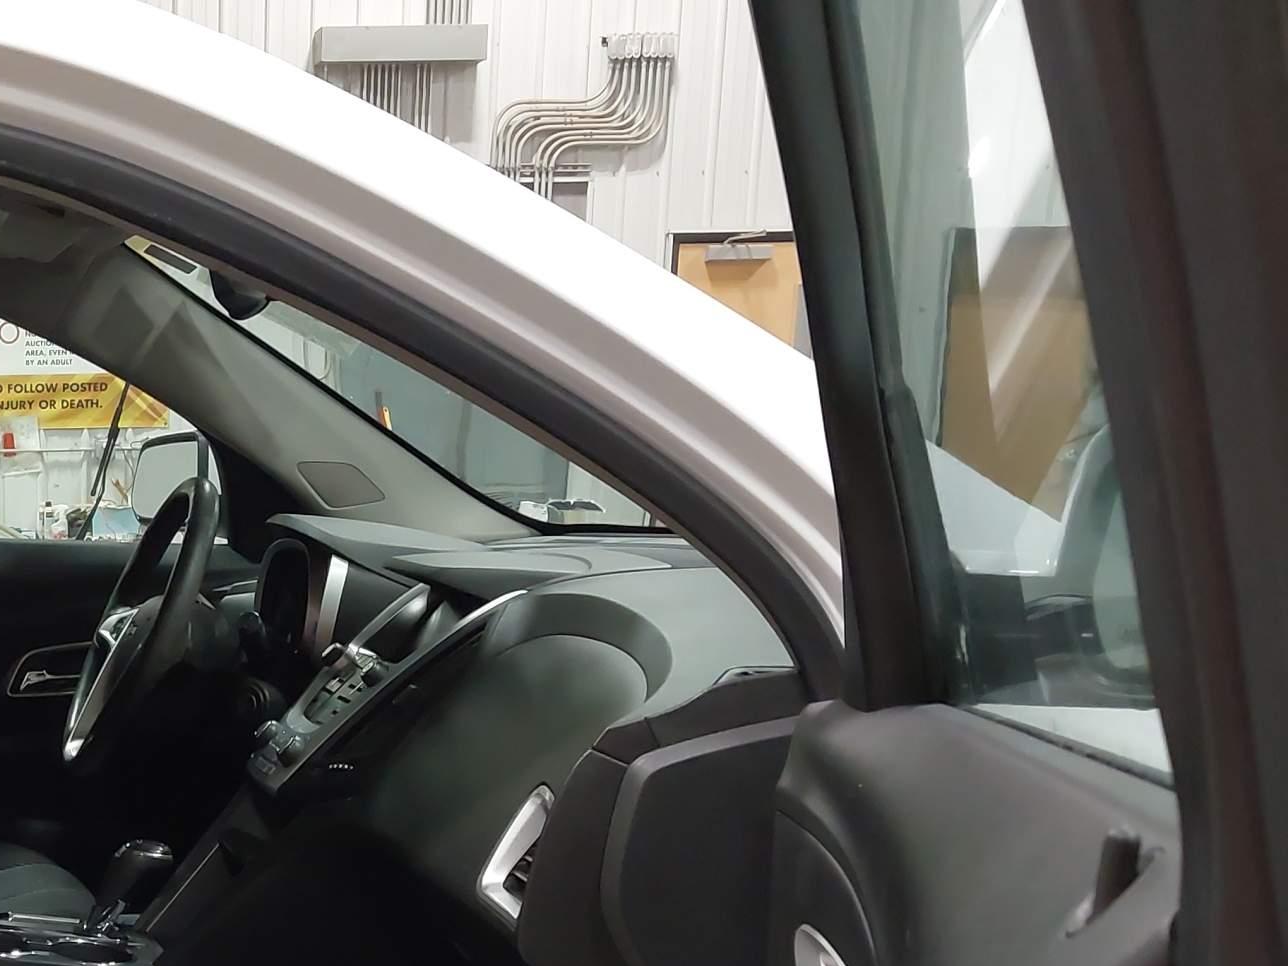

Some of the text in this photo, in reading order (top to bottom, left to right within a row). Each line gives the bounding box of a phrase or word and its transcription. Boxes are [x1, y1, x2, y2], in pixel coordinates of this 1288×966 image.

[8, 383, 58, 393] FOLLOW
[63, 382, 107, 392] POSTED
[39, 400, 56, 409] OR
[61, 399, 102, 409] DEATH.
